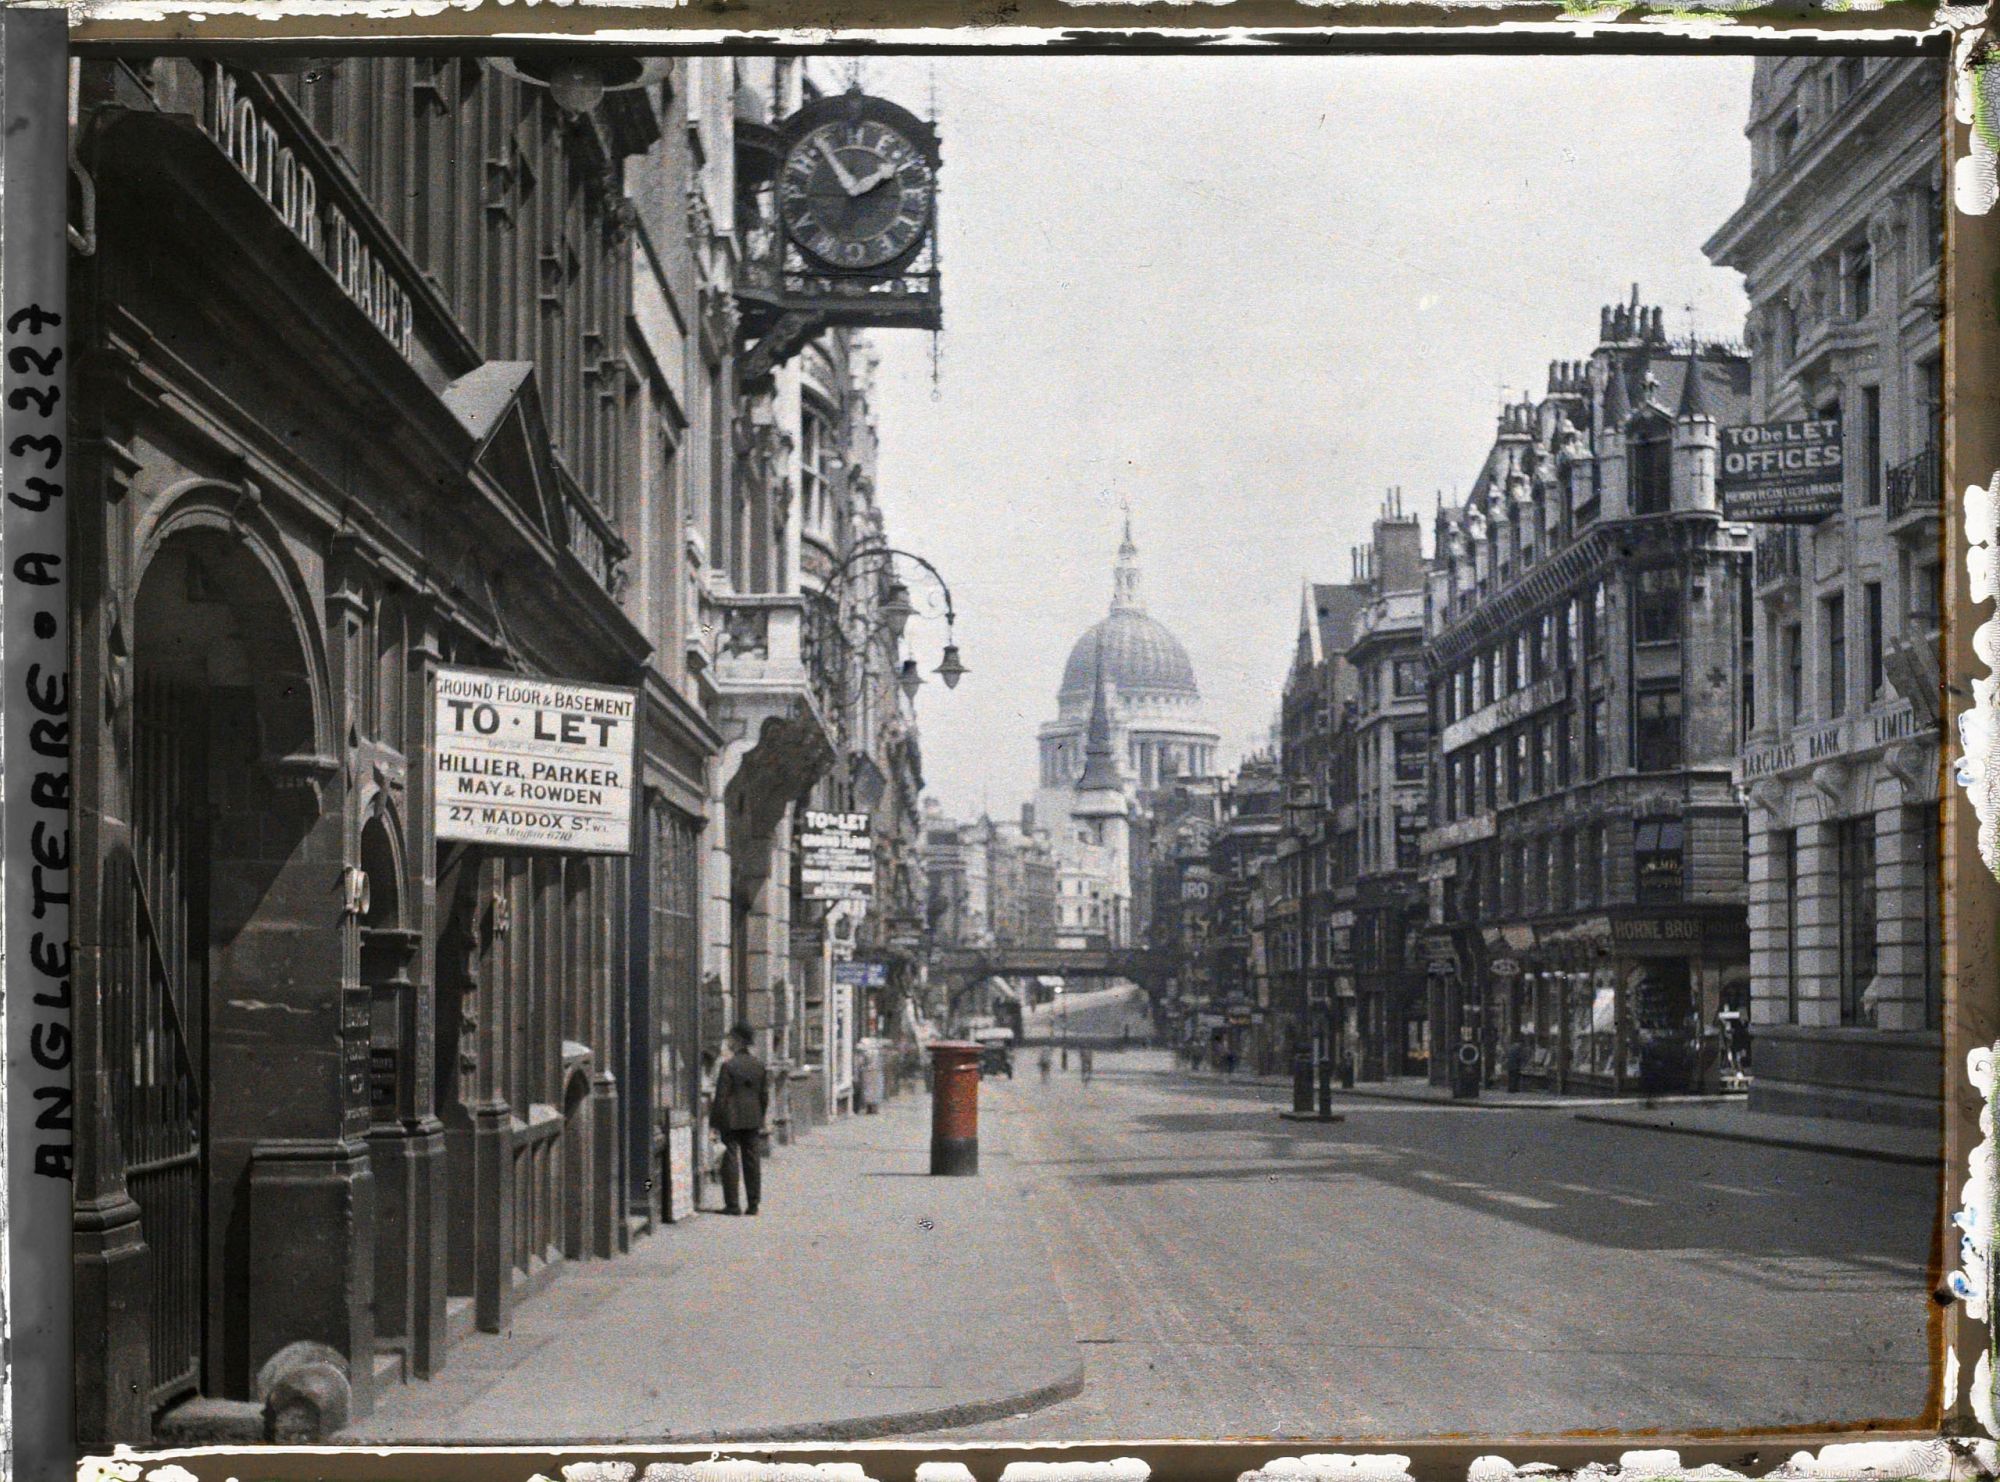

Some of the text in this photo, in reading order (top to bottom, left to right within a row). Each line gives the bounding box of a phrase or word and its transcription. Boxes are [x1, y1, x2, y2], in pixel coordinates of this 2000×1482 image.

[214, 61, 414, 364] MOTOR TRADER
[1727, 427, 1759, 447] TO
[1761, 427, 1783, 442] be
[1786, 420, 1838, 441] LET
[1725, 445, 1841, 474] OFFICES
[497, 684, 541, 704] FLOOR
[542, 695, 552, 706] &
[555, 692, 632, 717] BASEMENT
[447, 700, 501, 735] TO
[534, 711, 618, 748] LET
[6, 302, 72, 1183] ANGLETERRE A 43227
[1810, 727, 1840, 758] BANK
[439, 753, 525, 780] HILLIER,
[458, 777, 602, 806] MAY & ROWDEN
[482, 809, 563, 829] MADDOX
[805, 811, 828, 829] TO
[838, 813, 868, 831] LET
[1614, 920, 1662, 940] HORNE
